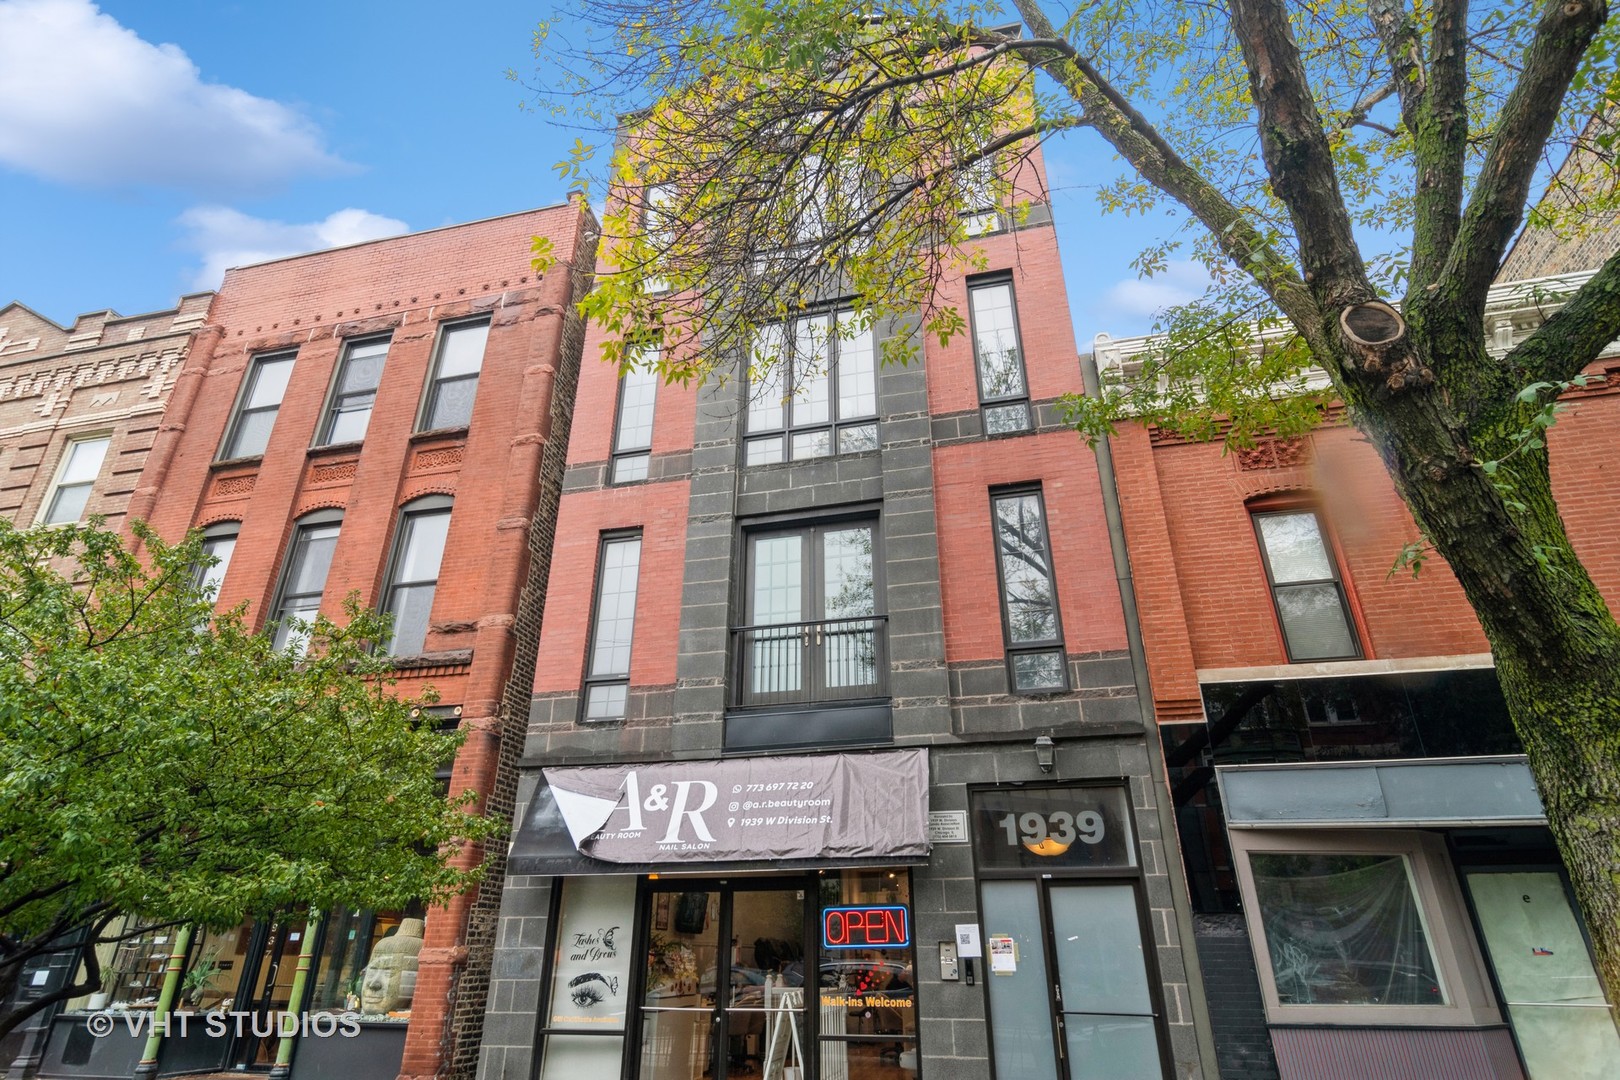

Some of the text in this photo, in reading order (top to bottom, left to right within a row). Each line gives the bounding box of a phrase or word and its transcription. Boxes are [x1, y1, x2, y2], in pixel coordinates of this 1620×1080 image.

[746, 781, 814, 792] 773 697 72 20
[742, 799, 831, 811] @a.r.beautyroom
[741, 815, 833, 826] 1939 W Division St.
[999, 810, 1105, 846] 1939
[587, 831, 642, 840] EAUTY ROOM
[658, 842, 711, 851] NAIL SALON
[826, 909, 905, 944] OPEN
[570, 948, 589, 961] and
[821, 995, 912, 1008] Walk-ins Welcome
